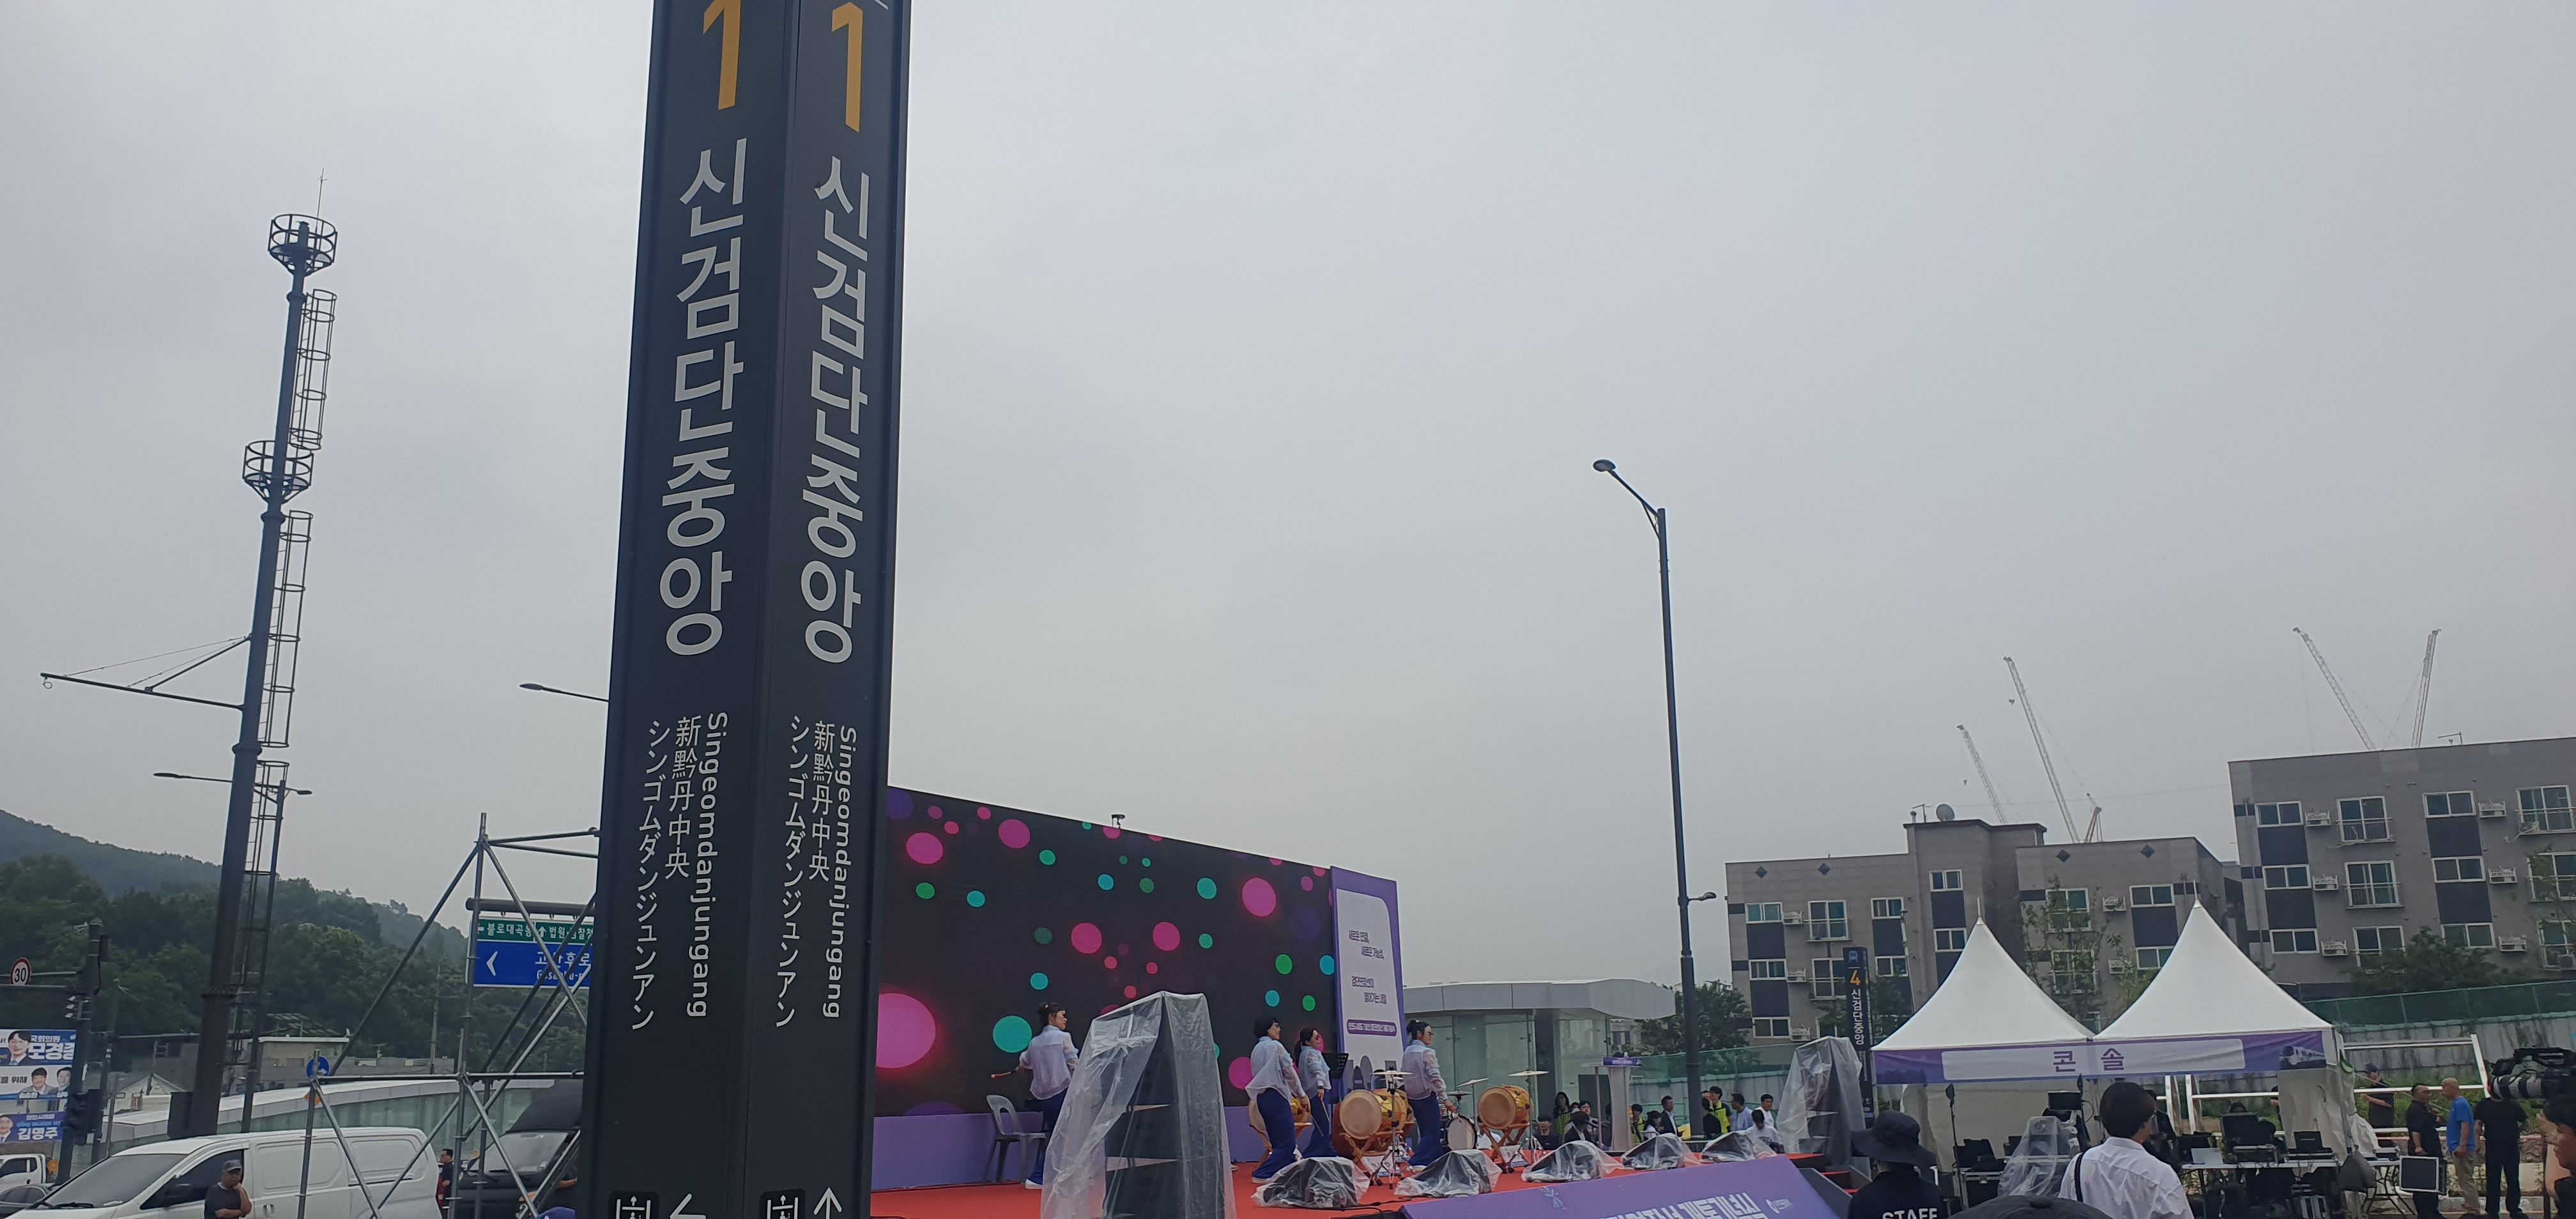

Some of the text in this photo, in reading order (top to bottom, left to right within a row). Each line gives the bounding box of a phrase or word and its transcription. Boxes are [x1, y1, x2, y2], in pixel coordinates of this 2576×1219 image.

[703, 0, 741, 110] 1
[832, 2, 863, 132] 1
[660, 138, 747, 656] 신검단중앙
[801, 156, 870, 663] 신검단중앙
[632, 721, 670, 1030] シンゴムダンジュンアン
[687, 712, 728, 1017] Singeomdanjungang
[776, 715, 810, 1027] シンゴムダンジュンアン
[822, 725, 857, 1018] Singeomdanjungang
[14, 967, 26, 983] 30
[487, 923, 532, 937] 불로대곡동
[1850, 970, 1861, 986] 4
[1851, 988, 1864, 1045] 신검단중앙
[18, 1126, 59, 1140] 김명주
